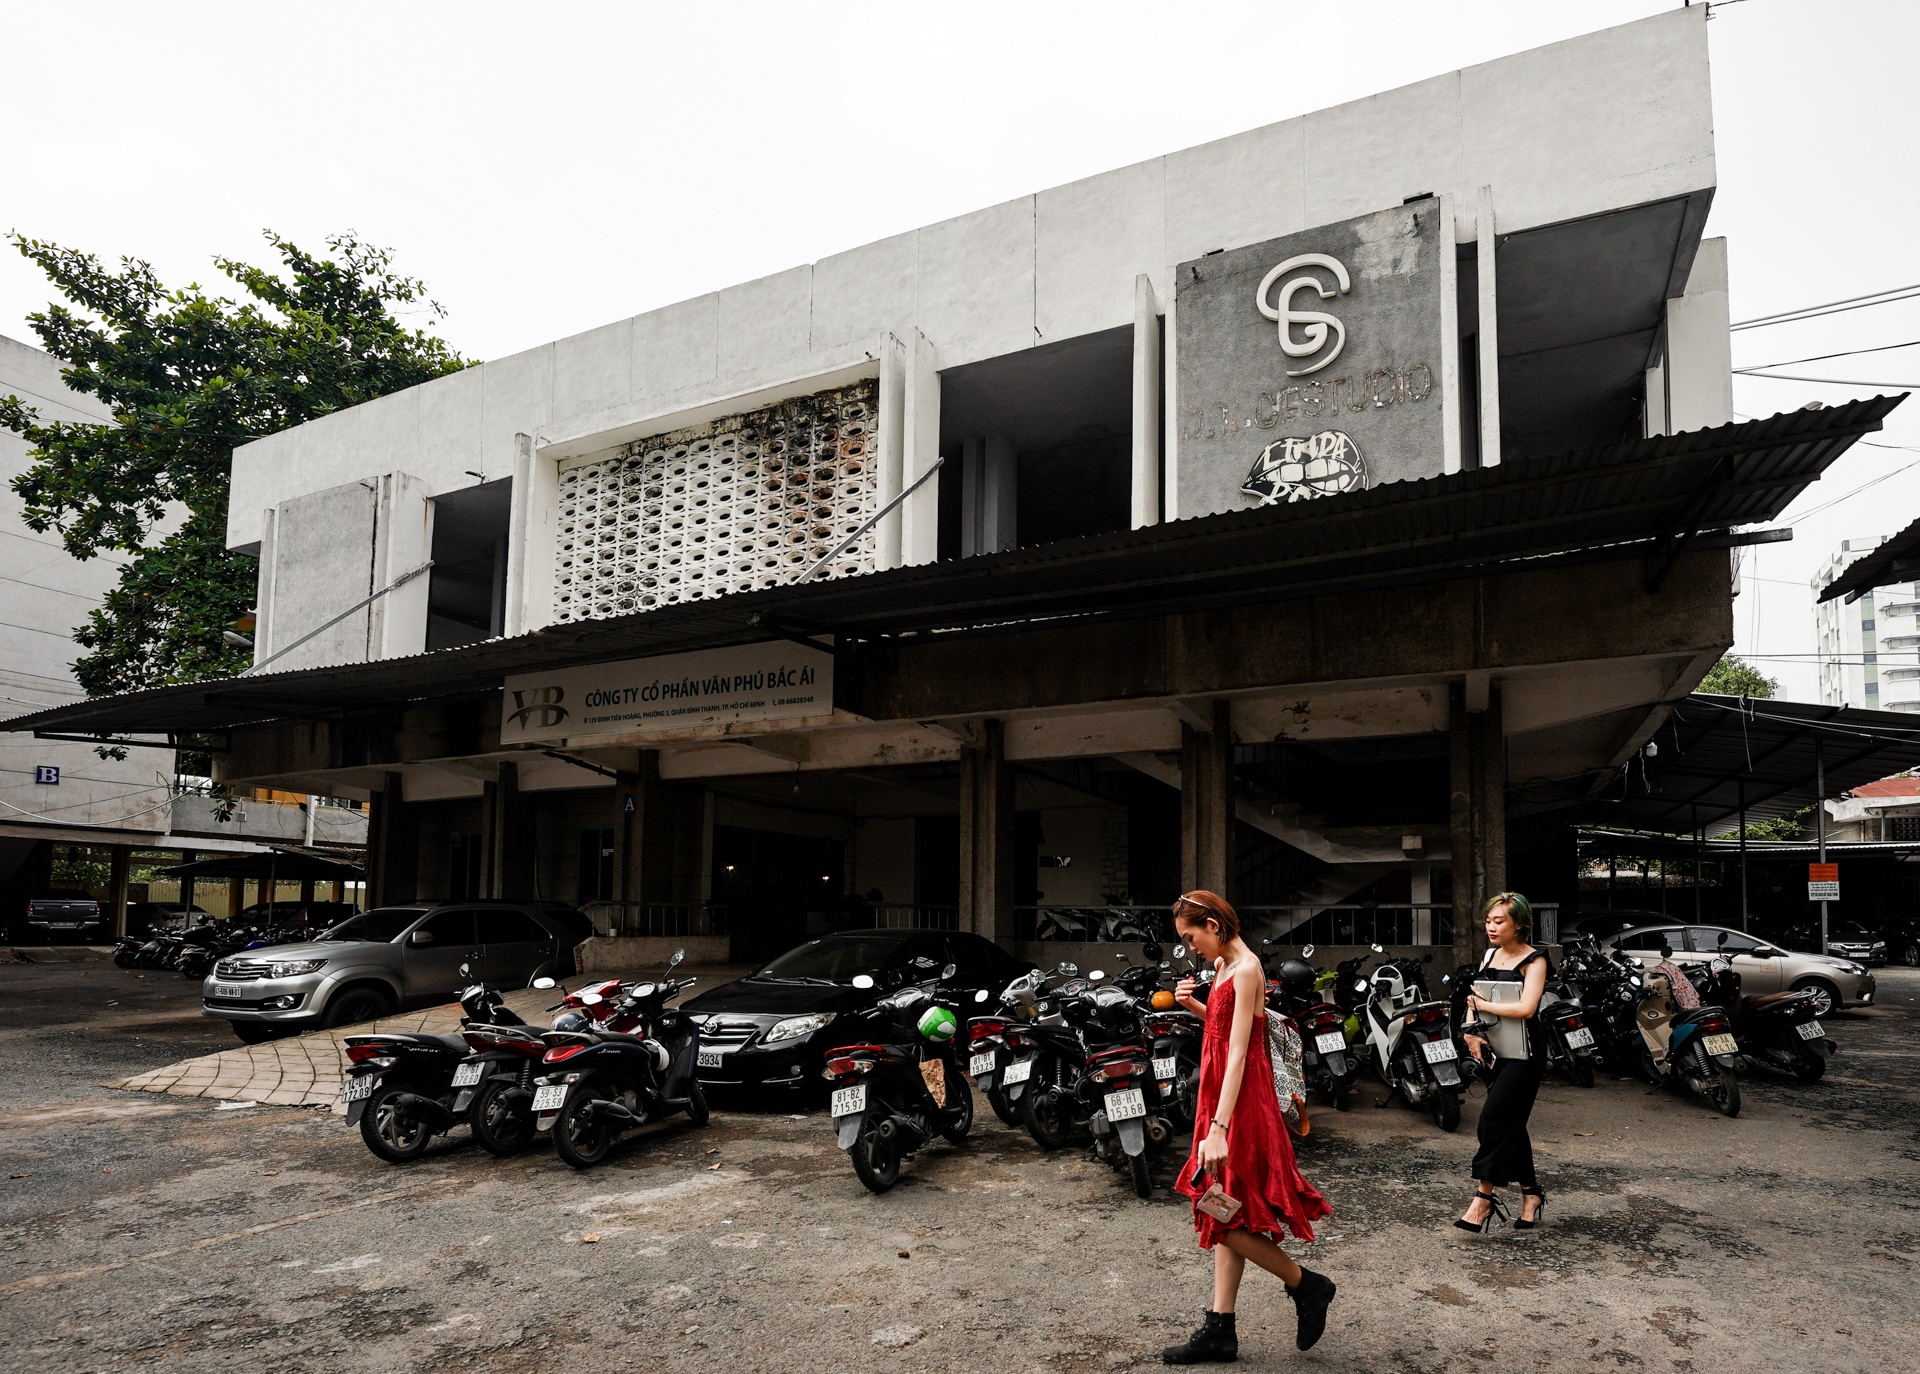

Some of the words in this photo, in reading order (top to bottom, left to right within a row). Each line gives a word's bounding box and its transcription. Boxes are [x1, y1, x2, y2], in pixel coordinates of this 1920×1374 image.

[585, 689, 620, 707] CÔNG
[623, 688, 639, 703] TY
[641, 680, 659, 701] CỔ
[662, 677, 699, 699] PHẦN
[702, 675, 730, 695] VĂN
[734, 670, 763, 691] PHÚ
[767, 666, 796, 688] BẮC
[799, 665, 814, 685] ÁI
[750, 700, 765, 708] MINH
[38, 767, 58, 783] B
[624, 797, 635, 811] A
[837, 1088, 860, 1103] 81-B2
[1110, 1092, 1137, 1107] 68-H1
[834, 1099, 863, 1115] 715.97
[1110, 1103, 1143, 1119] 153.68
